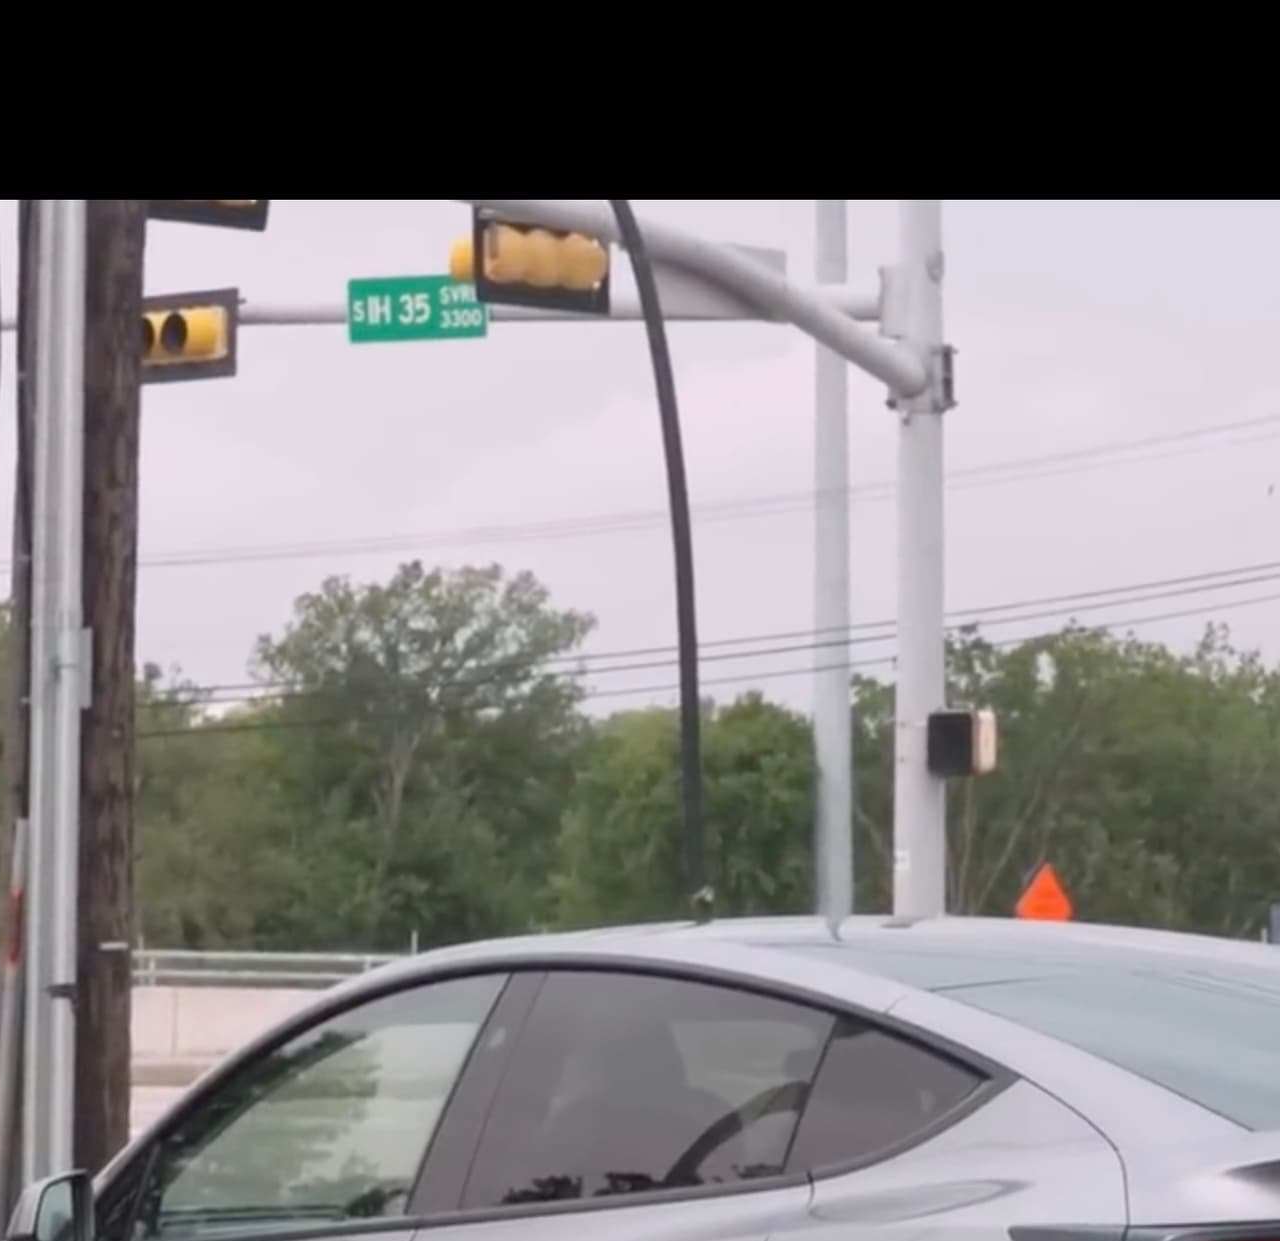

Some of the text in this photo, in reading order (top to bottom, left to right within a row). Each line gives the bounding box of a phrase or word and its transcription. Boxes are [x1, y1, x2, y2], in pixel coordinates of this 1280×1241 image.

[439, 285, 478, 305] SVR
[399, 293, 431, 324] 35
[439, 309, 482, 328] 3300
